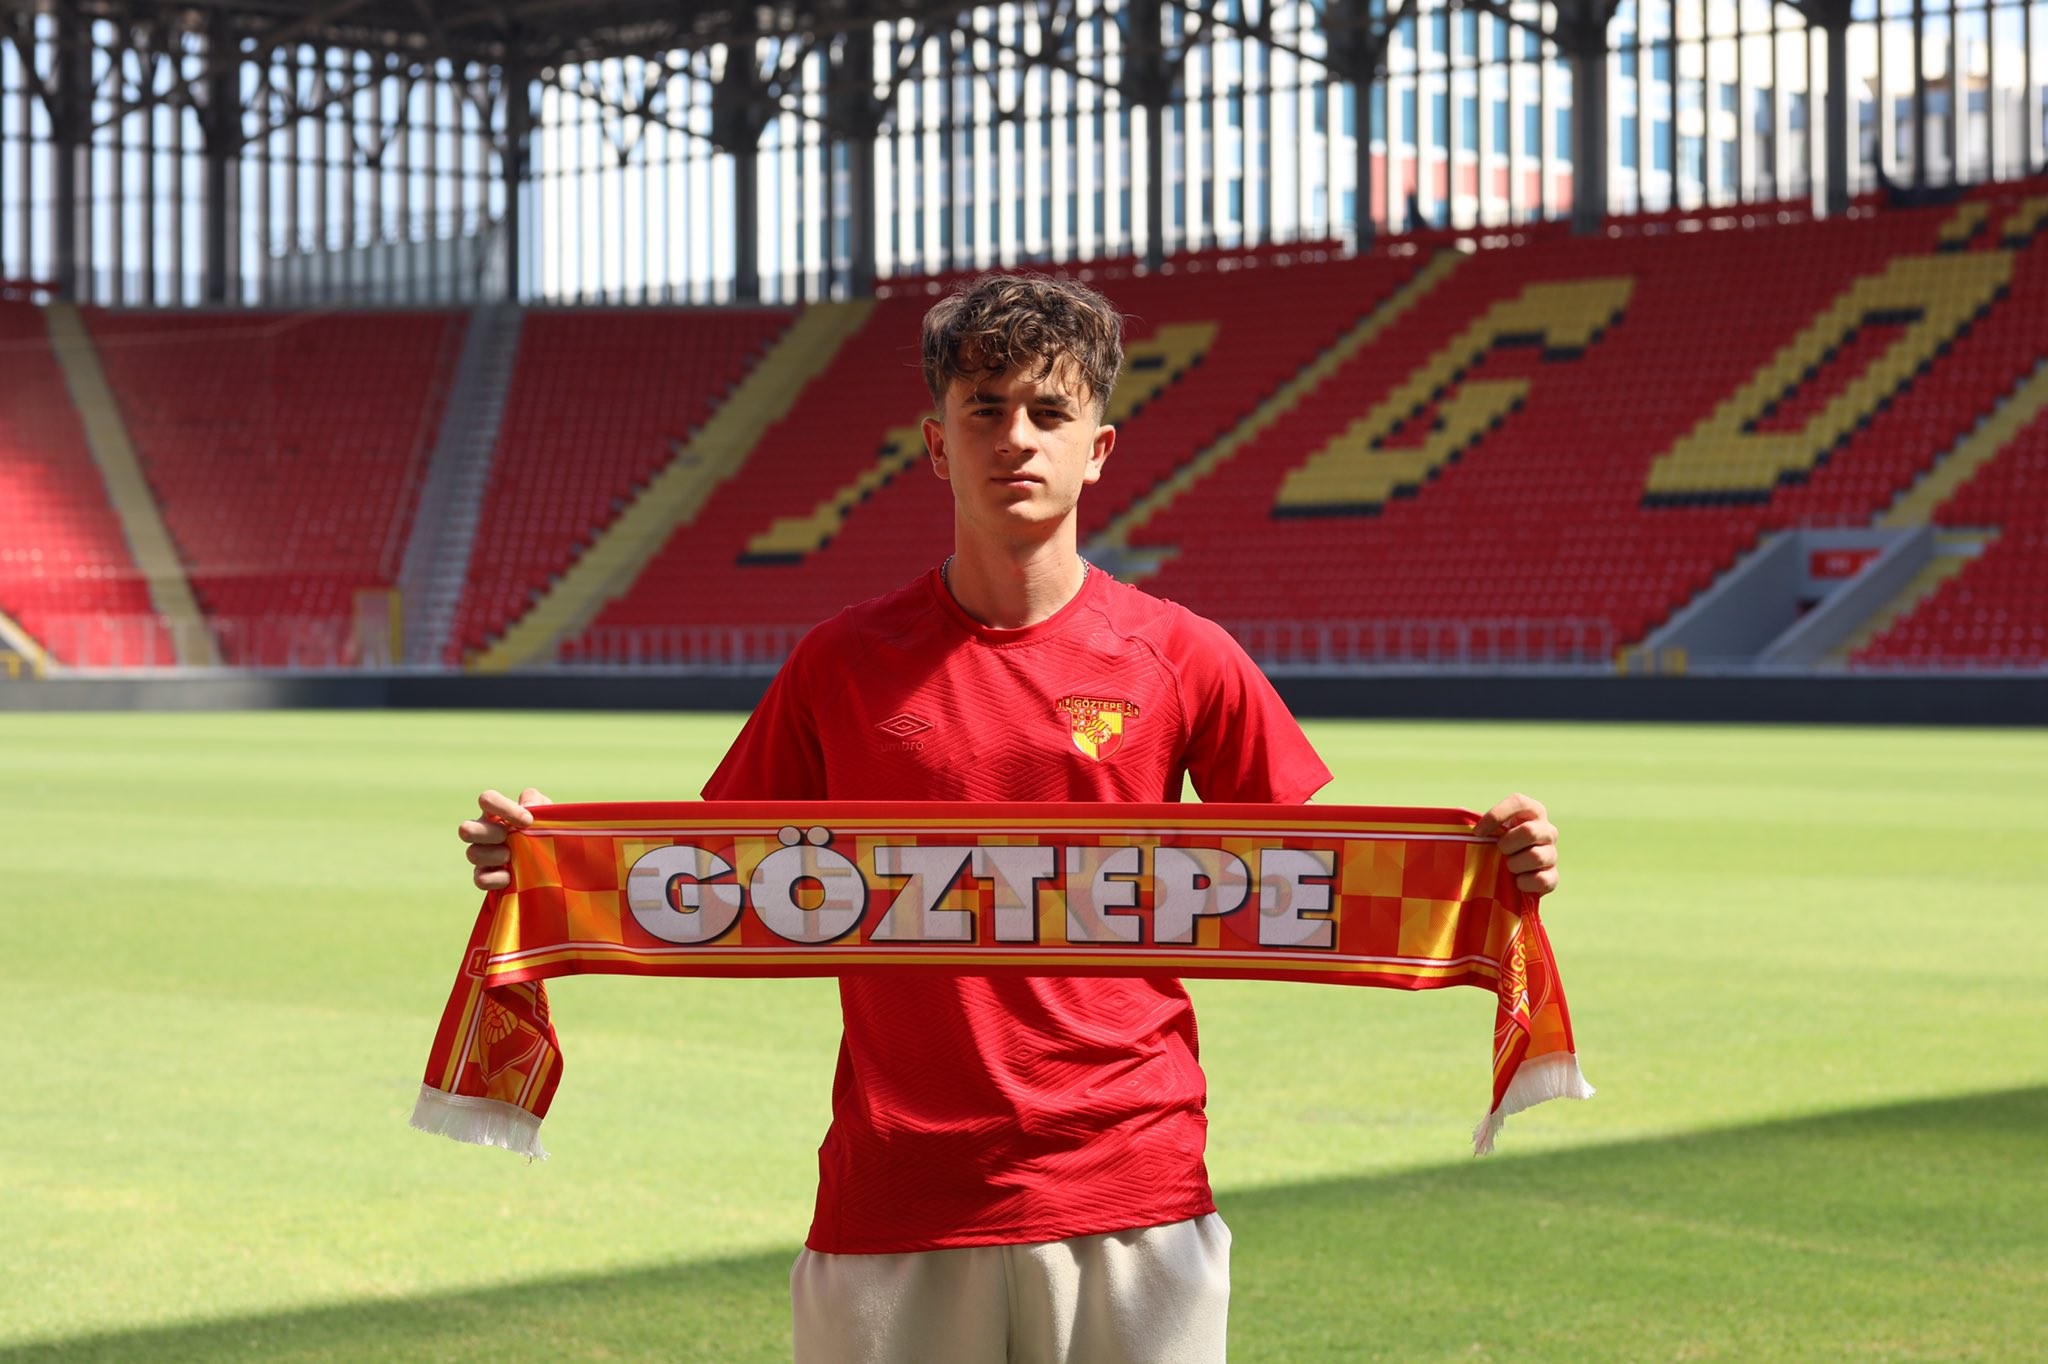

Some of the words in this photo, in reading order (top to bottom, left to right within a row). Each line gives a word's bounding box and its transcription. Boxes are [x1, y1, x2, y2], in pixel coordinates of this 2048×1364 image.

[1074, 698, 1122, 711] GÖZTEPE
[880, 741, 924, 753] umbro
[626, 825, 1339, 948] GÖZTEPE
